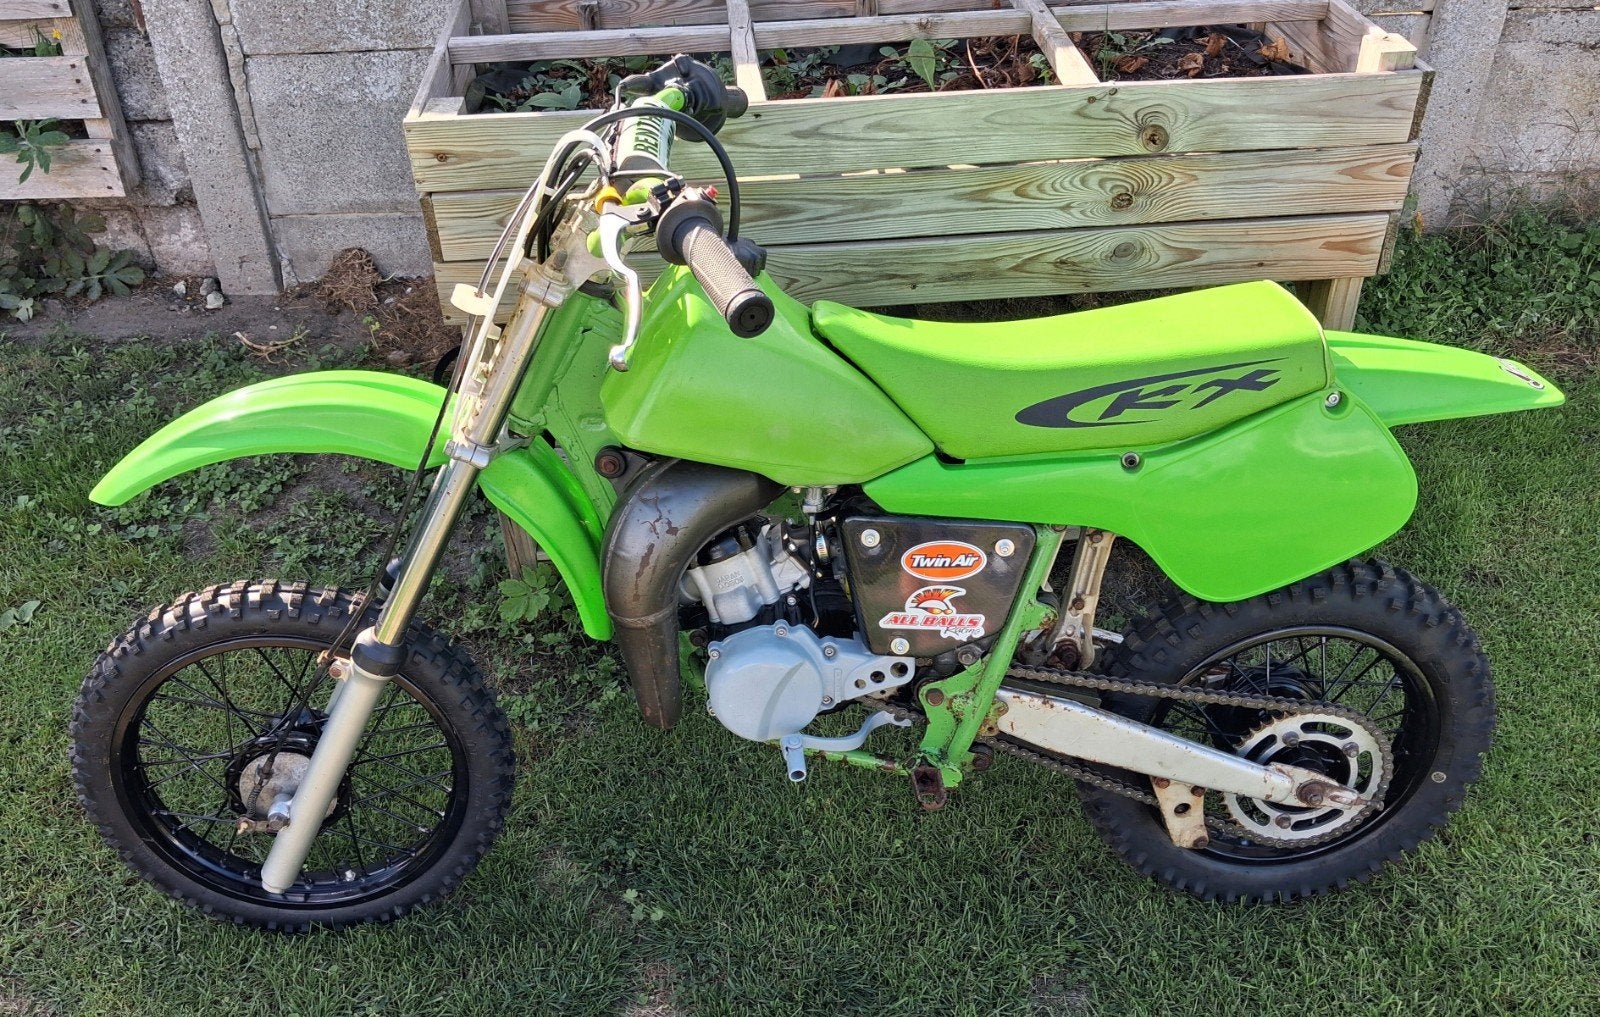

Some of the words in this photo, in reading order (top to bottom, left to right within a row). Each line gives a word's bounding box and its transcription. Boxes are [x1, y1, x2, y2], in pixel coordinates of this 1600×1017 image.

[911, 554, 951, 568] Twin
[951, 553, 980, 568] Air
[884, 614, 920, 626] ALL
[920, 615, 981, 629] BALLS
